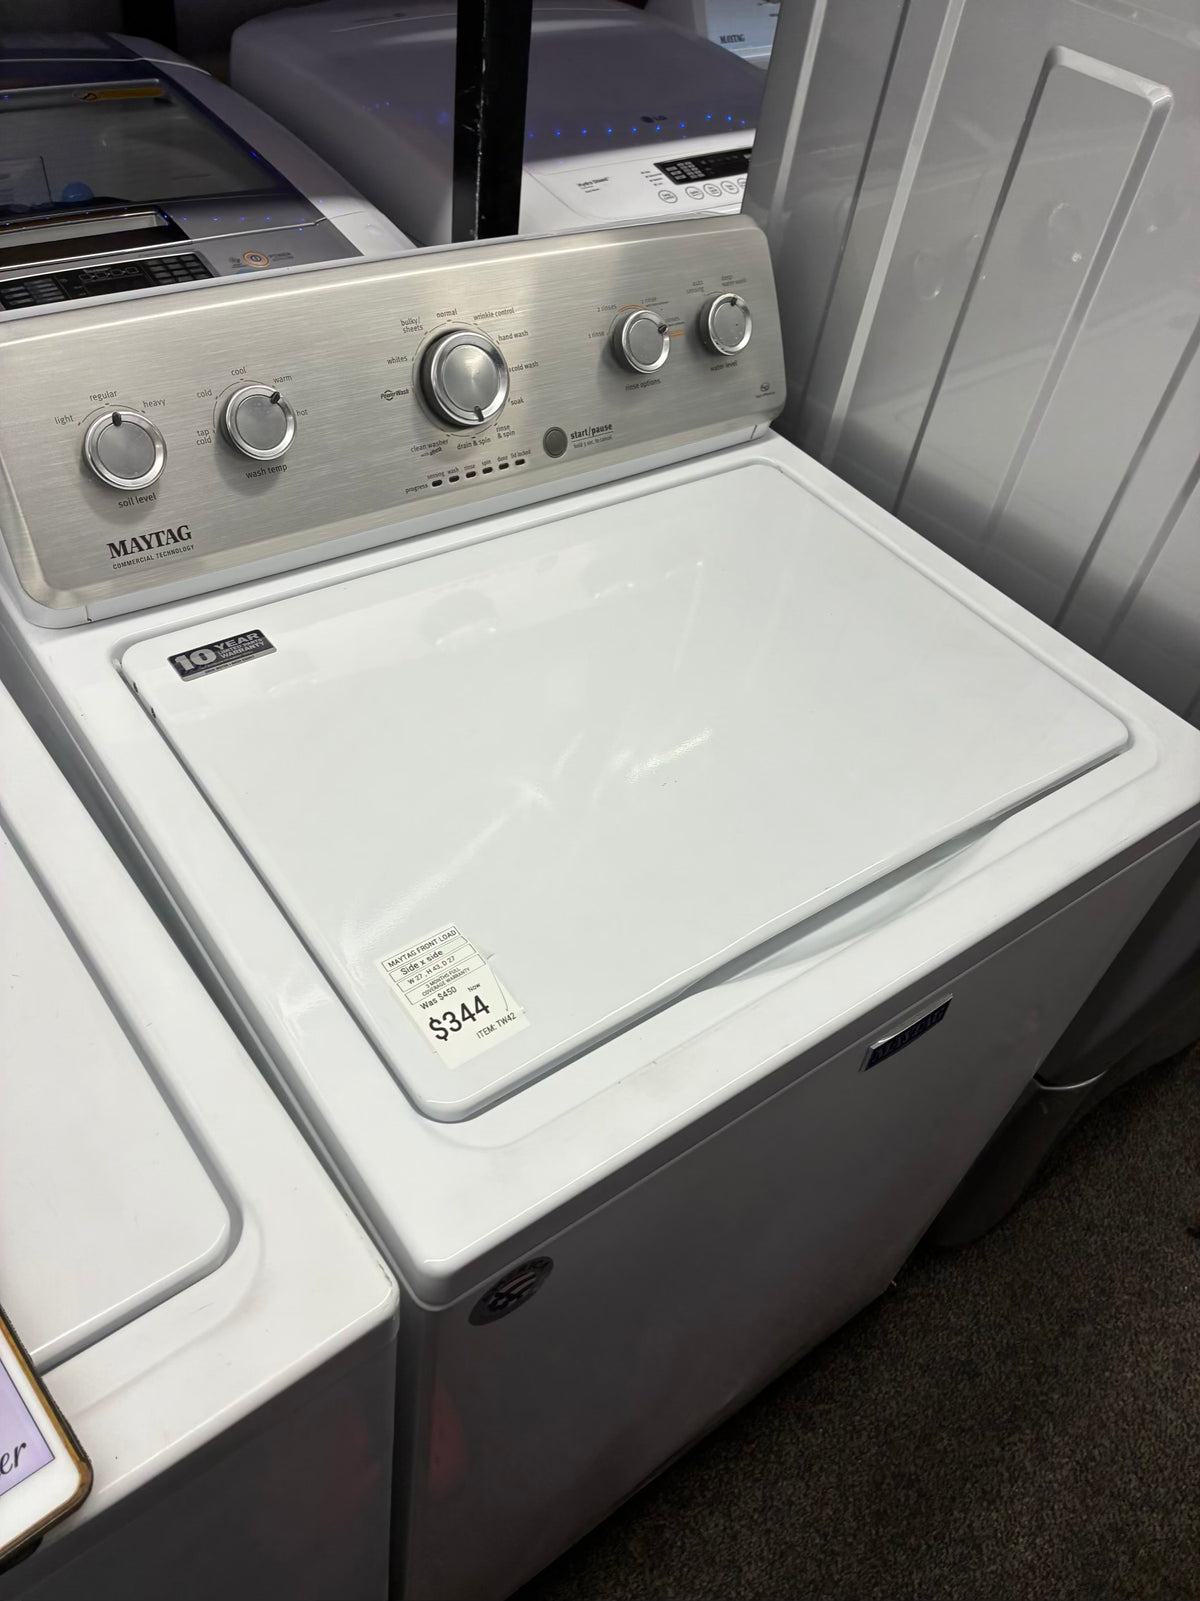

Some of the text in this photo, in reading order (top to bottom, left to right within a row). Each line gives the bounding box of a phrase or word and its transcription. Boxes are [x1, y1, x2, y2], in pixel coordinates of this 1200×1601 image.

[436, 308, 457, 318] normal
[473, 307, 515, 321] wrinkle control
[402, 324, 423, 333] sheets
[498, 330, 529, 341] hand wash
[386, 355, 408, 365] whites
[230, 367, 247, 376] cool
[511, 361, 539, 372] cold wash
[273, 373, 293, 383] warm
[625, 378, 661, 391] rinse options
[89, 390, 118, 402] regular
[196, 388, 213, 399] cold
[143, 398, 166, 409] heavy
[510, 397, 524, 405] soak
[296, 408, 309, 418] hot
[54, 414, 75, 426] light
[196, 428, 210, 438] tap
[496, 424, 511, 432] rinse
[570, 422, 614, 440] start/pause
[503, 429, 515, 439] spin
[196, 435, 213, 446] cold
[410, 438, 448, 453] clean washer
[456, 440, 473, 451] drain
[479, 436, 492, 445] spin
[245, 463, 288, 480] wash temp
[427, 471, 445, 480] sensing
[447, 466, 459, 475] wash
[405, 483, 429, 494] progress
[117, 492, 157, 509] soil level
[106, 524, 193, 560] MAYTAG
[112, 545, 195, 570] COMMERCIAL TECHNOLOGY
[214, 633, 259, 650] YEAR
[219, 641, 264, 659] WARRANTY
[174, 648, 217, 671] 10
[388, 929, 457, 967] MAYTAG FRONT LOAD
[400, 962, 420, 976] Side
[426, 949, 443, 962] side
[448, 955, 456, 963] 27
[467, 983, 481, 993] Now
[419, 986, 457, 1010] Was $450
[428, 994, 491, 1042] $344
[476, 1012, 517, 1039] ITEM: TW42
